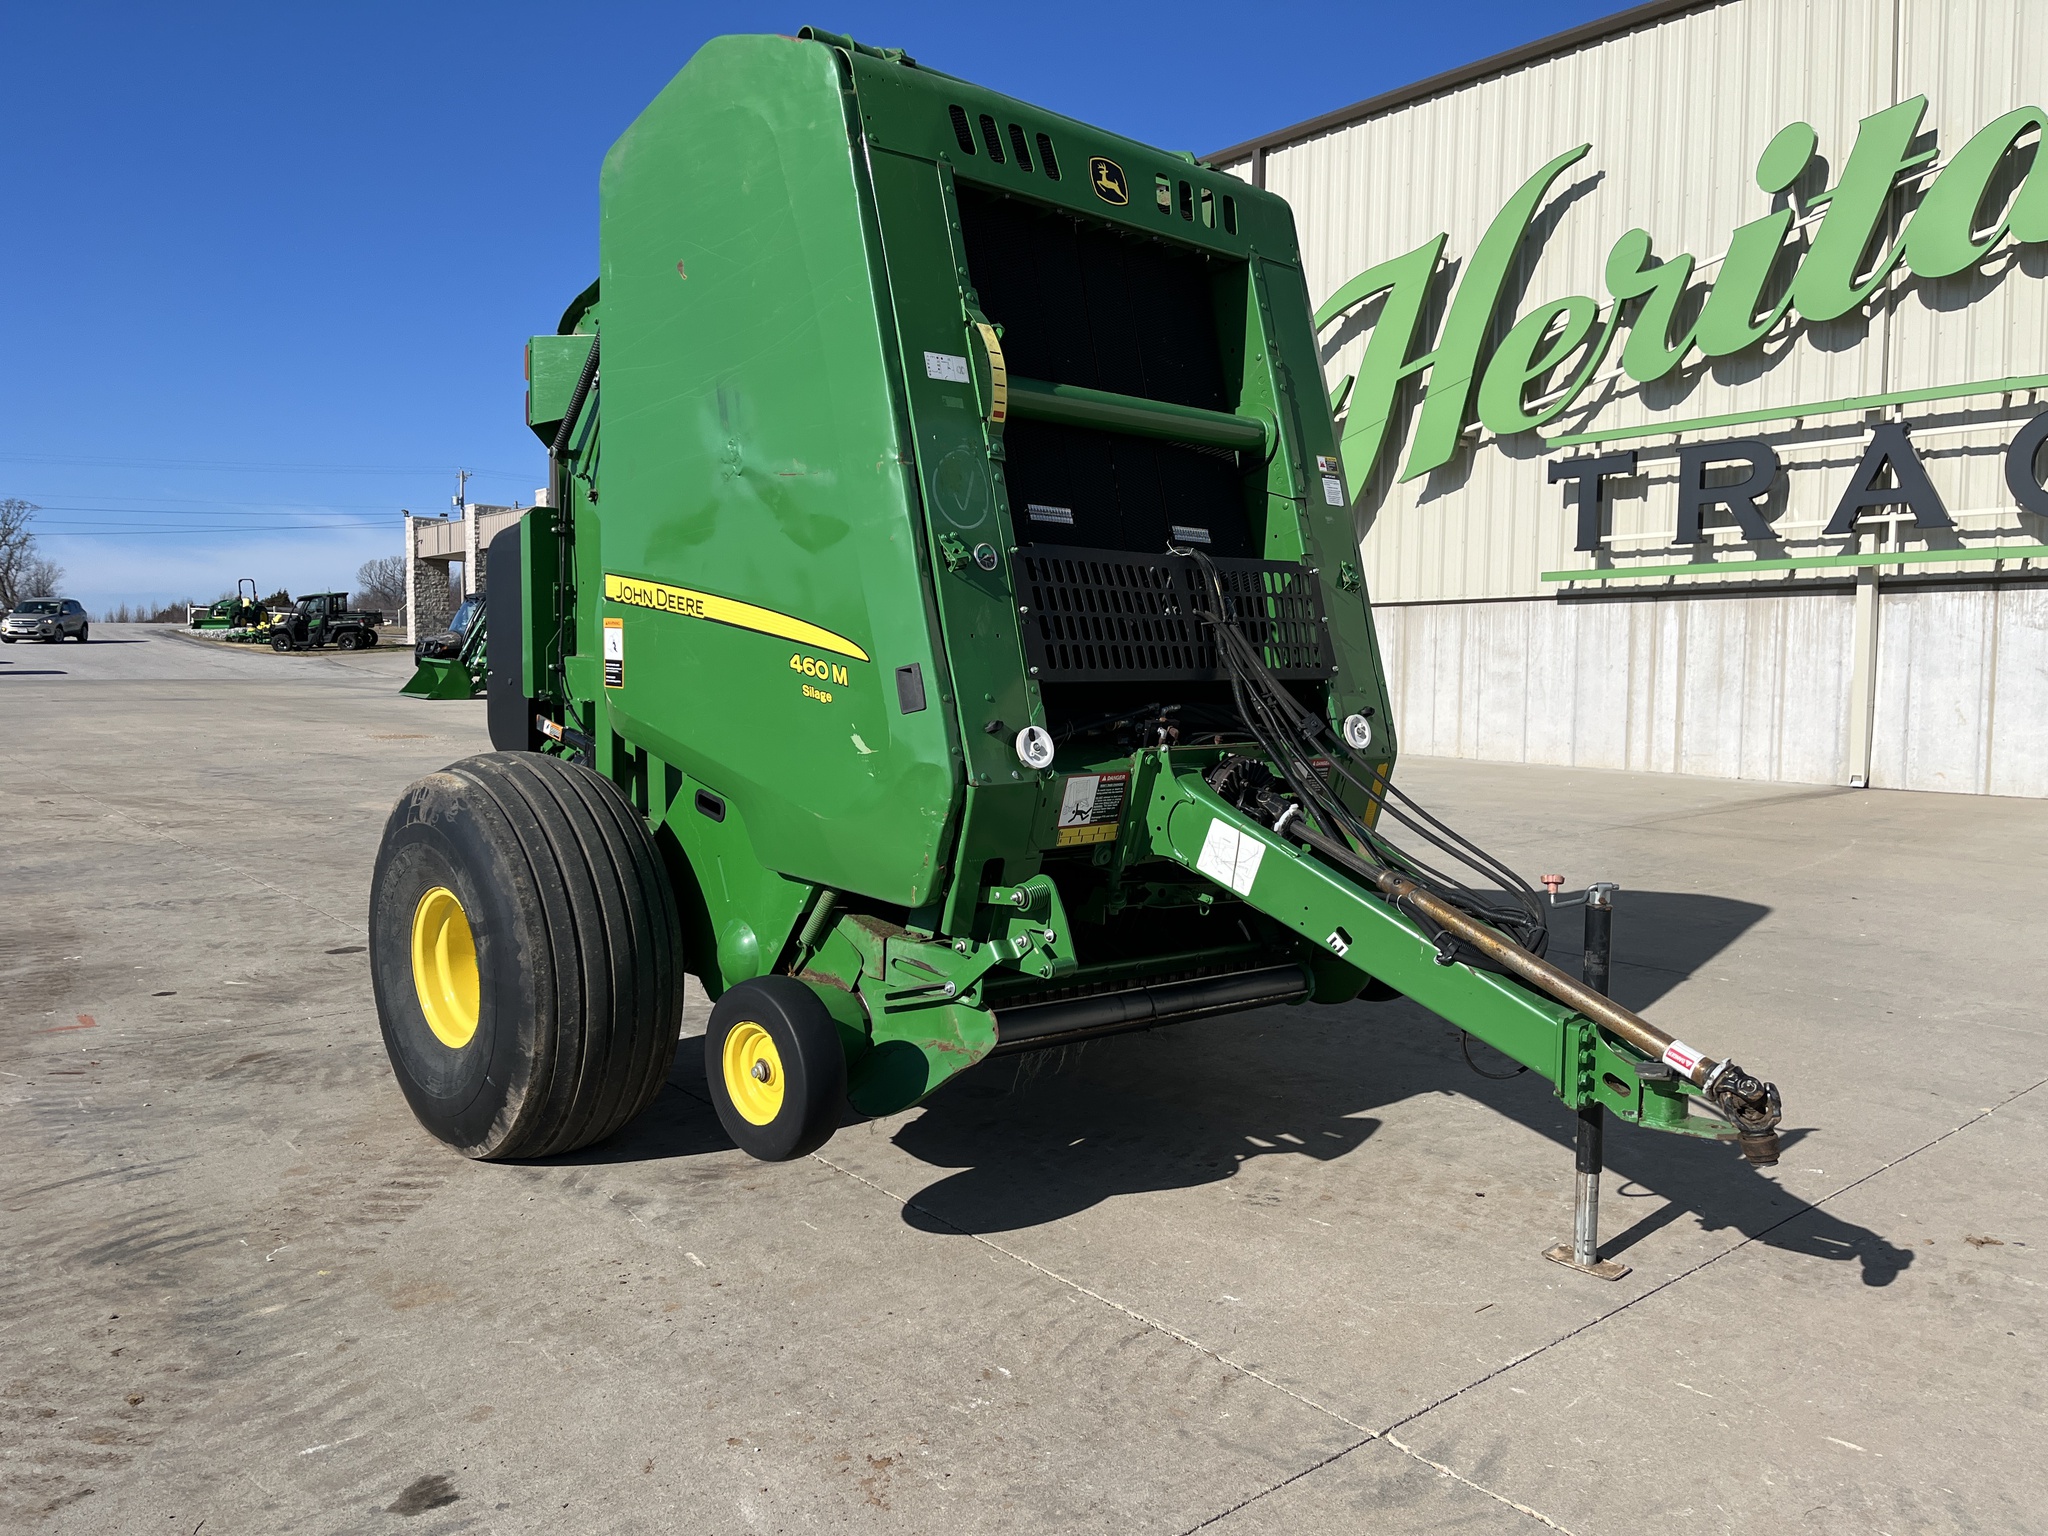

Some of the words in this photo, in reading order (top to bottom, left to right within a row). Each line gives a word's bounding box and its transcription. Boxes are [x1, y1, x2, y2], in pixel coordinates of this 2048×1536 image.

[616, 582, 653, 605] JOHN
[656, 588, 704, 615] DEERE
[789, 653, 829, 681] 460
[831, 662, 849, 687] M
[802, 684, 833, 704] Silage
